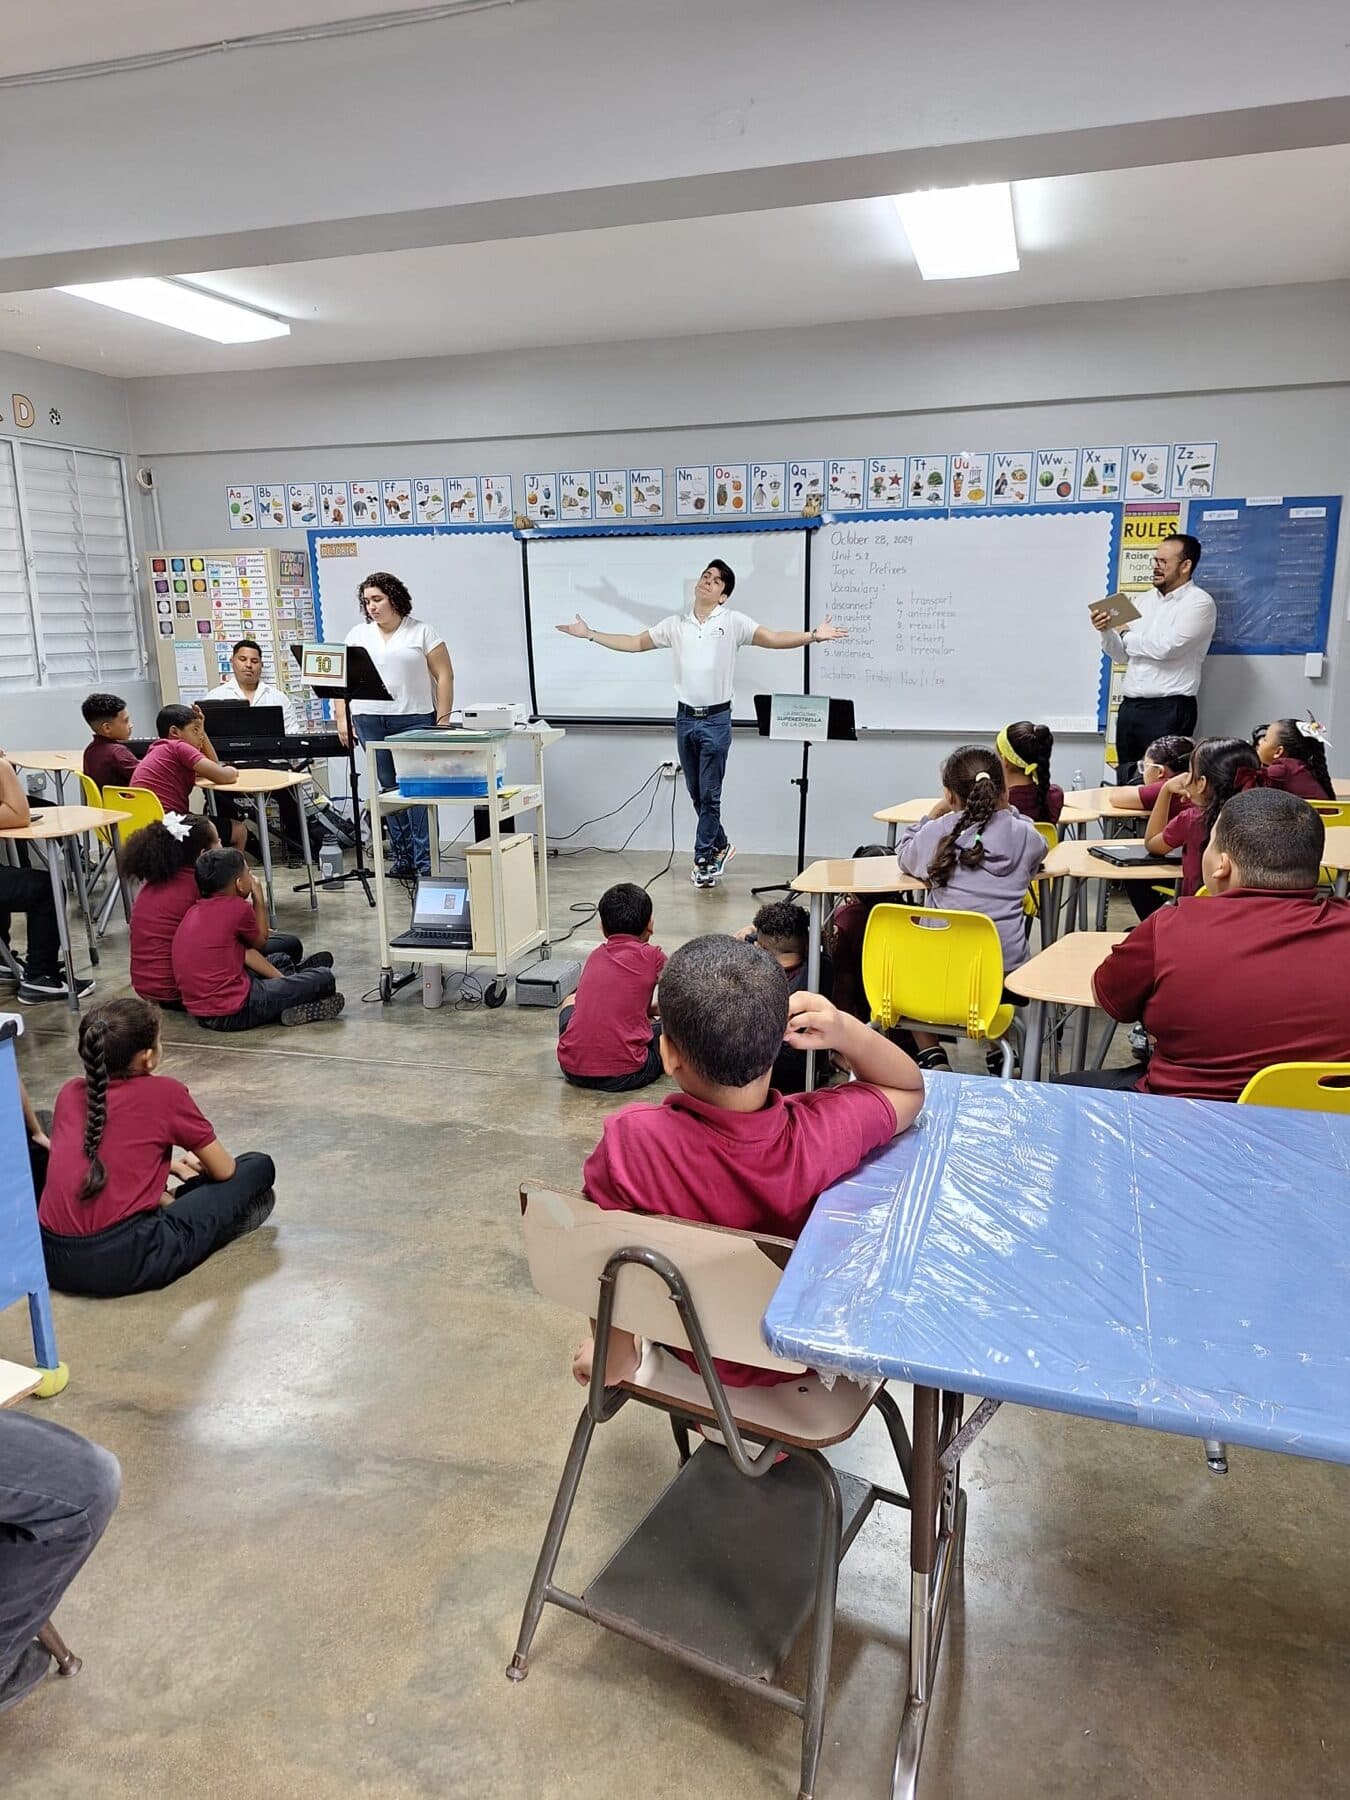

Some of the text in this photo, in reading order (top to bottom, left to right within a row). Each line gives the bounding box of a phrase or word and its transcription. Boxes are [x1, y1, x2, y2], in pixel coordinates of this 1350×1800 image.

[1, 393, 36, 428] D
[1039, 453, 1063, 465] Ww
[1085, 450, 1101, 463] Xx
[1131, 449, 1147, 464] Yy
[1177, 447, 1194, 460] Zz
[871, 460, 886, 473] Ss
[913, 458, 927, 471] Tt
[954, 458, 969, 470] Uu
[997, 456, 1012, 468] Vv
[715, 468, 730, 480] Oo
[753, 466, 767, 480] Pp
[791, 464, 807, 478] Qq
[831, 462, 845, 475] Rr
[561, 475, 575, 486] Kk
[598, 473, 608, 485] Ll
[631, 473, 651, 483] Mm
[678, 470, 693, 481] Nn
[352, 483, 365, 494] Ee
[384, 482, 396, 493] Ff
[416, 481, 430, 494] Gg
[449, 480, 462, 490] Hh
[484, 478, 494, 489] Ii
[528, 476, 539, 490] Jj
[229, 489, 241, 499] Aa
[259, 487, 271, 498] Bb
[289, 486, 302, 497] Cc
[320, 485, 333, 495] Dd
[1124, 522, 1177, 538] RULES
[831, 530, 913, 547] October 28, 2024
[831, 549, 851, 561] Unit
[1126, 551, 1149, 560] Raise
[869, 562, 906, 575] Prefixes
[315, 655, 332, 673] 10
